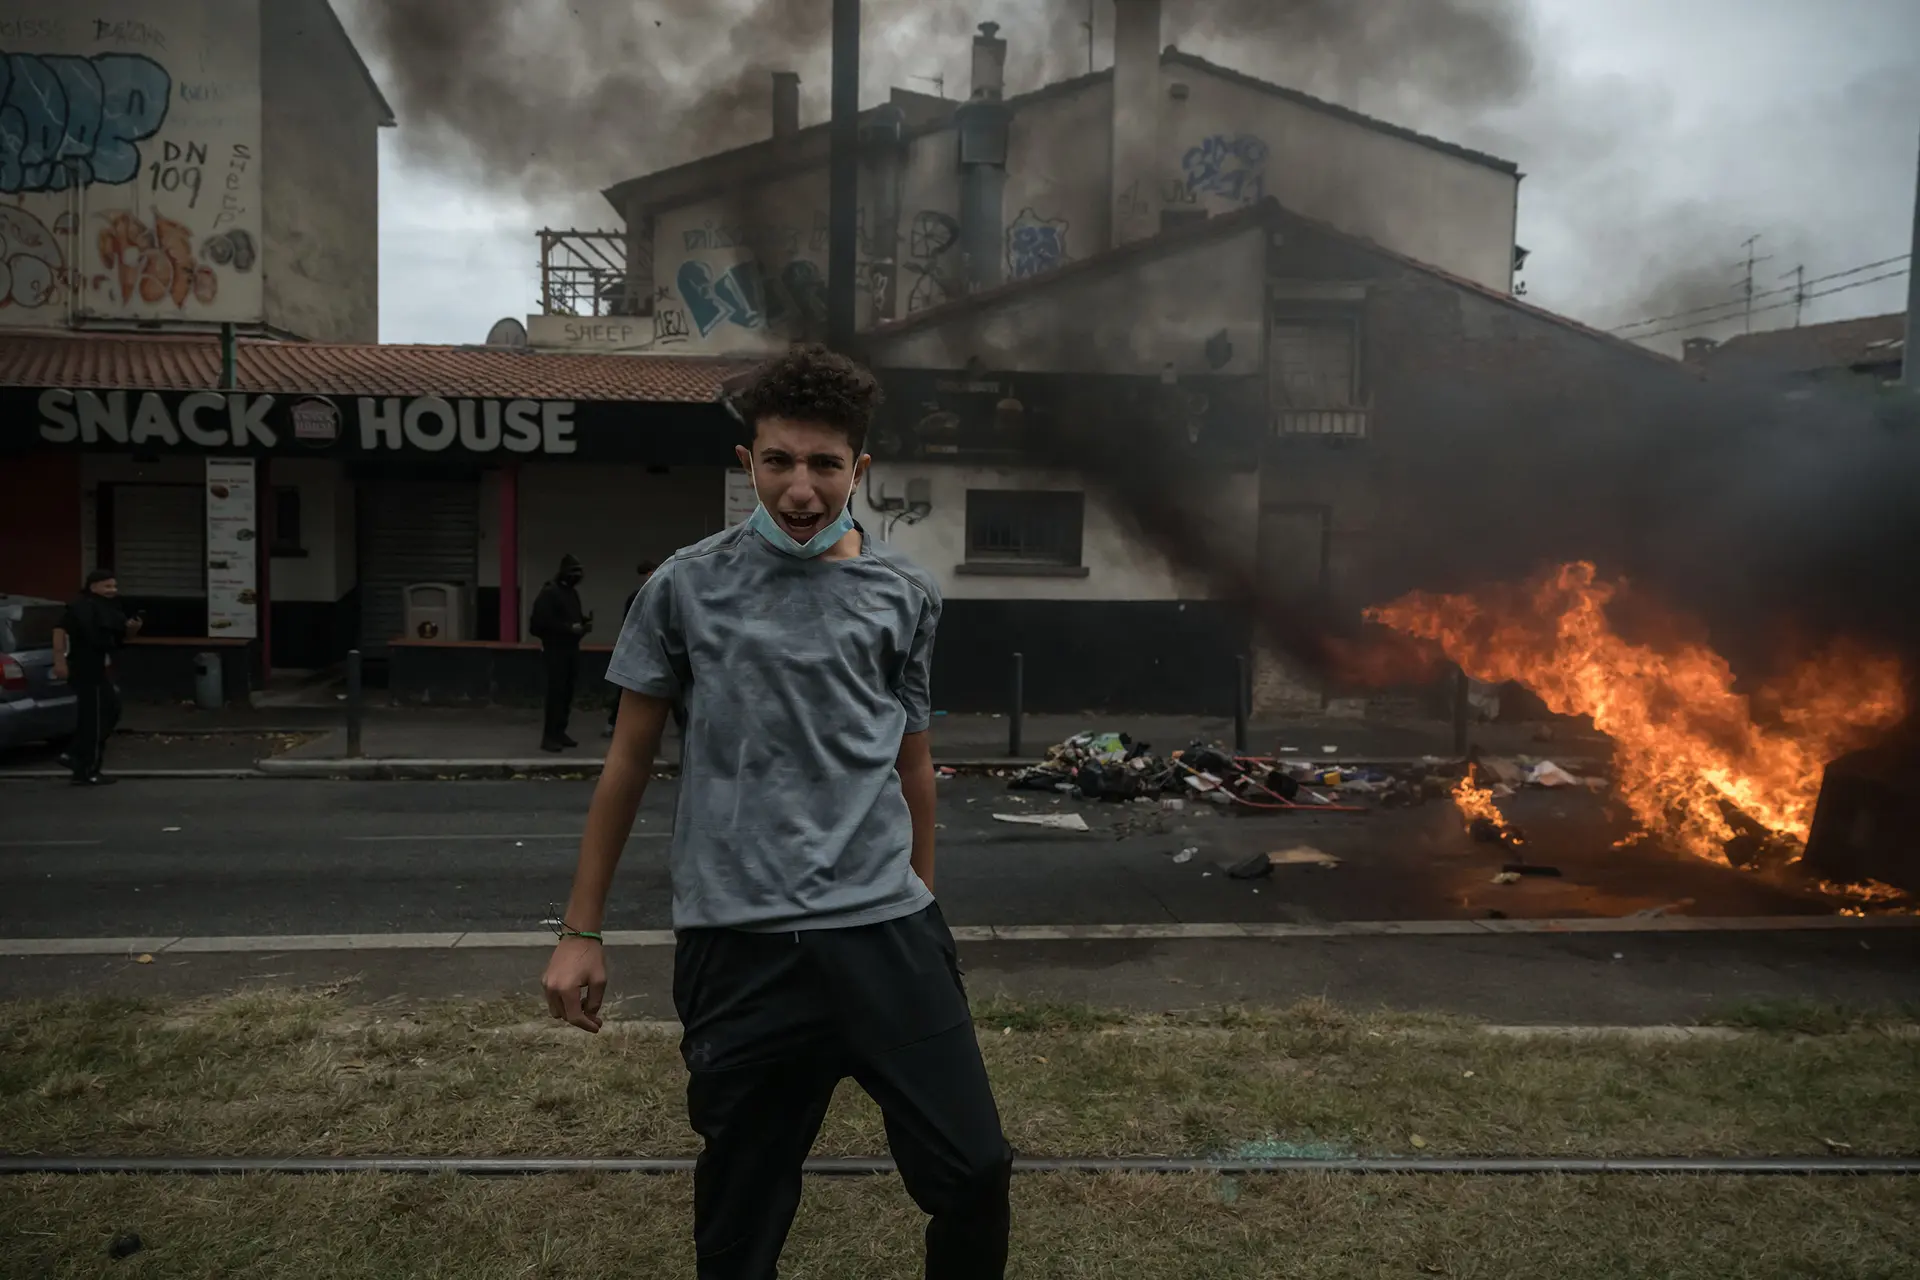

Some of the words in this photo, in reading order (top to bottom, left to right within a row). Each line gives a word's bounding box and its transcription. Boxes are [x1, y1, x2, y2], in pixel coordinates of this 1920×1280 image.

[163, 140, 208, 165] DN
[149, 161, 202, 209] 109
[564, 322, 633, 343] SHEEP
[38, 388, 278, 448] SNACK
[357, 395, 578, 454] HOUSE
